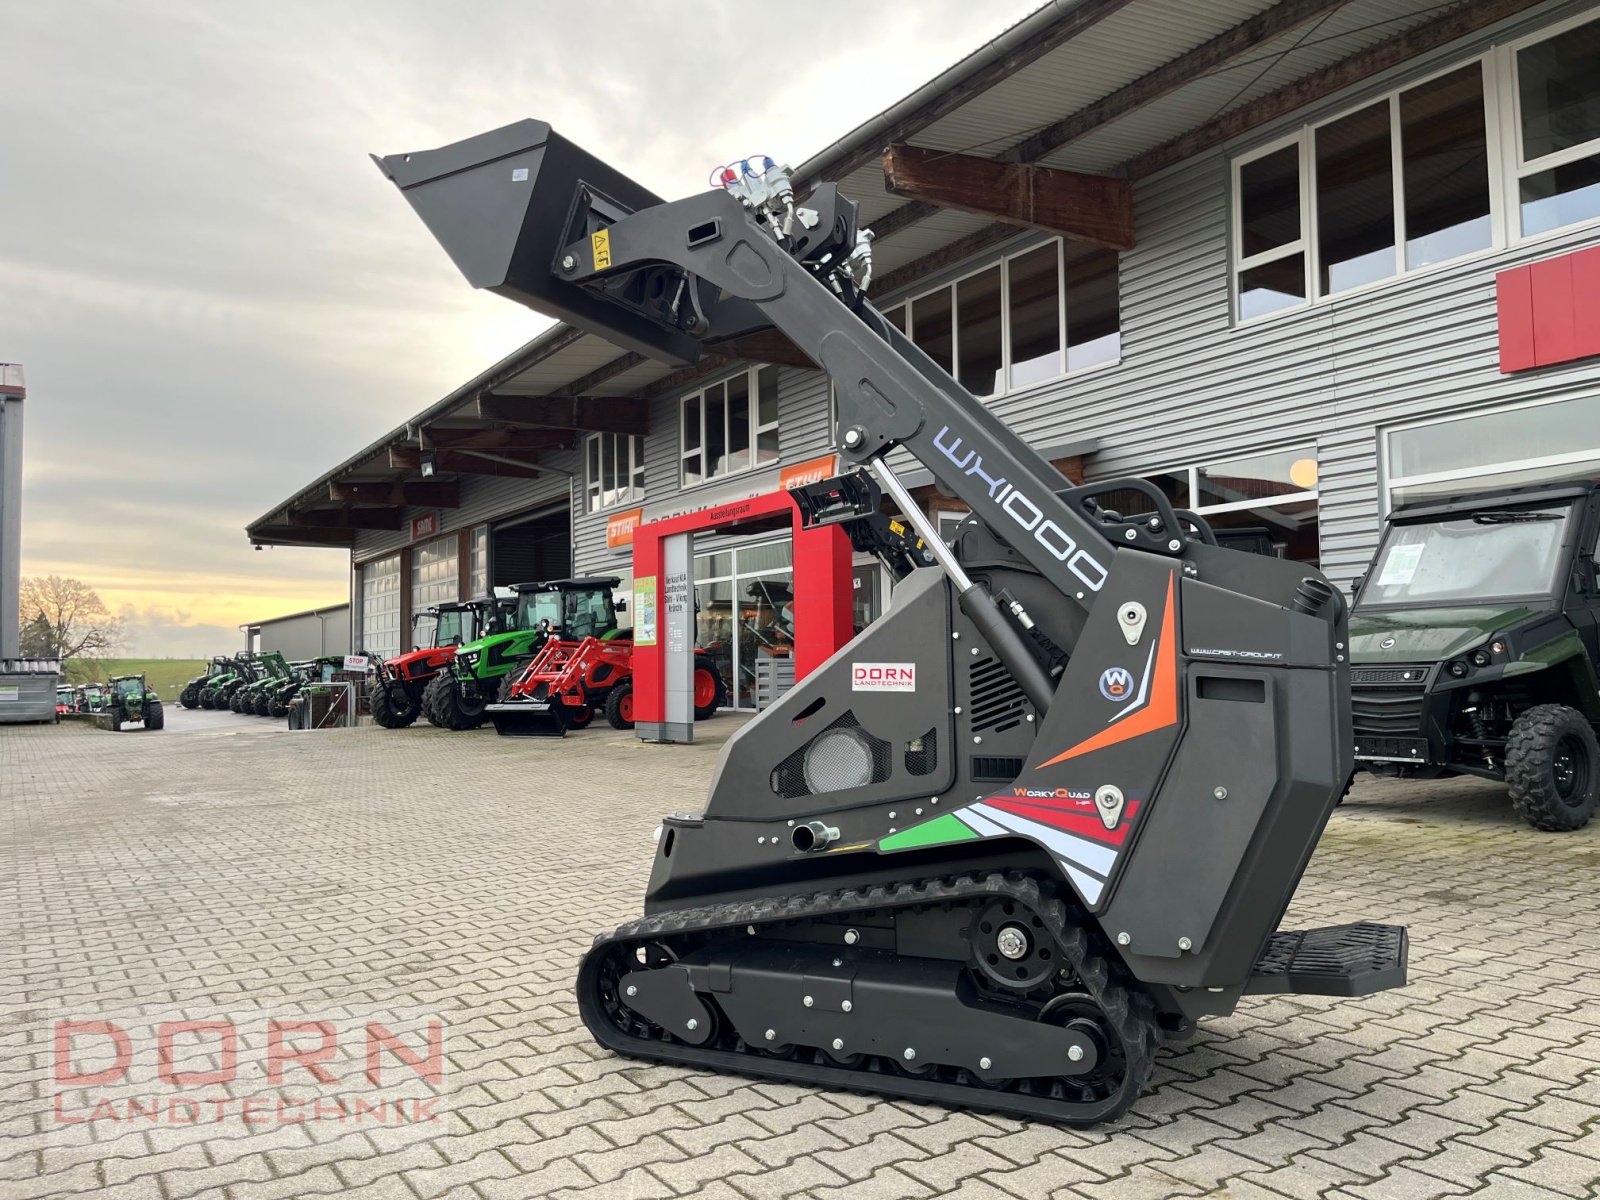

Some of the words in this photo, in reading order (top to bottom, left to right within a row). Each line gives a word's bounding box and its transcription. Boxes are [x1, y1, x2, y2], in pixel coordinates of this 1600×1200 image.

[665, 584, 687, 594] Landtechnik
[676, 593, 687, 604] Viking
[855, 669, 912, 680] DORN
